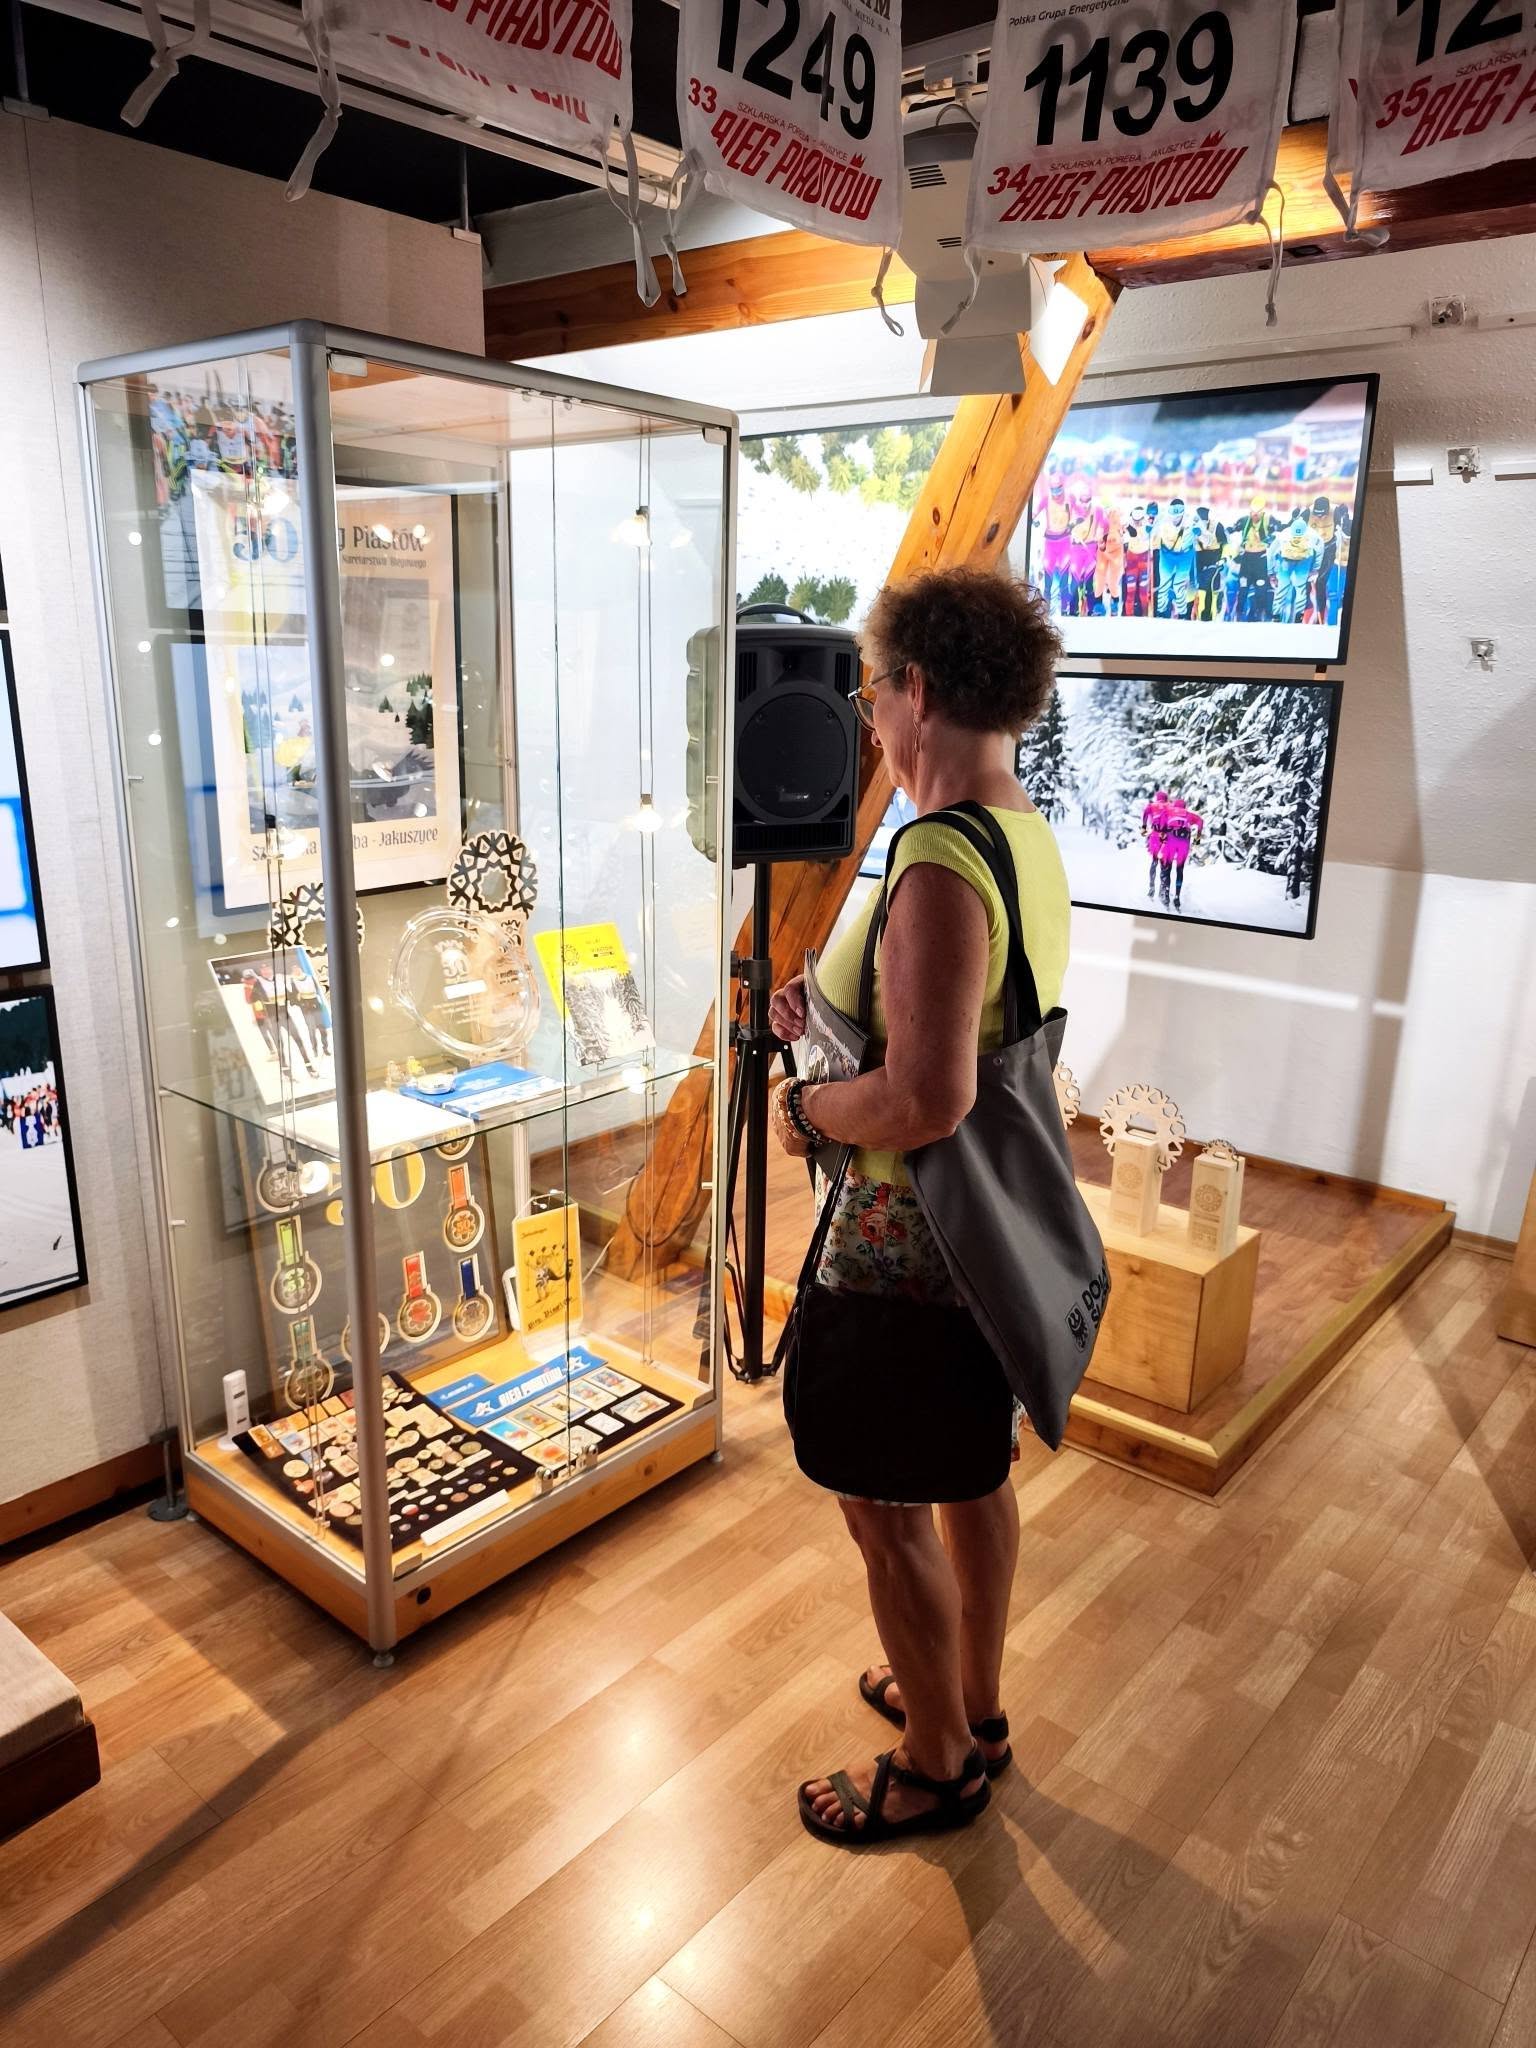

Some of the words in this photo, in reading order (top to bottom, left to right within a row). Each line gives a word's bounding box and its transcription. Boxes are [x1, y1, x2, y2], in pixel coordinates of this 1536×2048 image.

[1008, 16, 1036, 27] Polska
[1038, 8, 1066, 22] Grupa
[1397, 0, 1536, 66] 12
[718, 0, 876, 140] 1249
[1024, 11, 1234, 146] 1139
[1455, 48, 1528, 78] SZKLARSKA
[687, 77, 718, 114] 33
[736, 101, 786, 129] SZKLARSKA
[1375, 75, 1433, 130] 35
[1400, 63, 1523, 157] BIEG
[710, 109, 782, 177] BIEG
[765, 139, 883, 221] PIASTÓW
[986, 163, 1032, 195] 34
[998, 169, 1097, 222] BIEG
[1077, 142, 1249, 217] PIASTÓW
[1049, 158, 1101, 172] SZKLARSKA
[232, 515, 299, 563] 50
[378, 827, 439, 848] Jakuszyce
